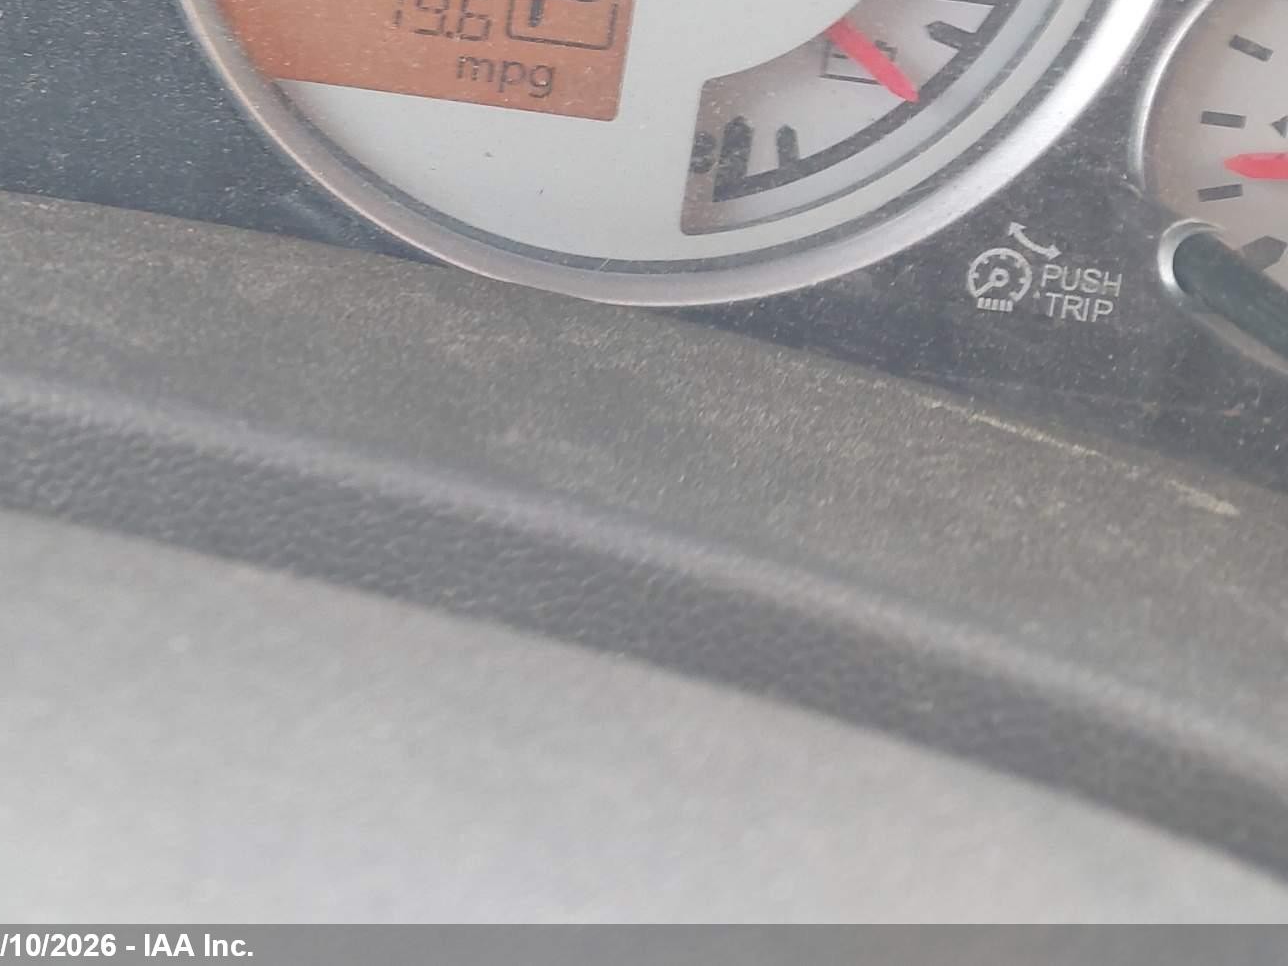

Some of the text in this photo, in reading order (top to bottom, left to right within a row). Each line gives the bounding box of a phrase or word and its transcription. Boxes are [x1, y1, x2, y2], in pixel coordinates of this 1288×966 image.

[457, 54, 555, 98] mpg
[1041, 265, 1121, 298] PUSH
[1045, 293, 1114, 324] TRIP
